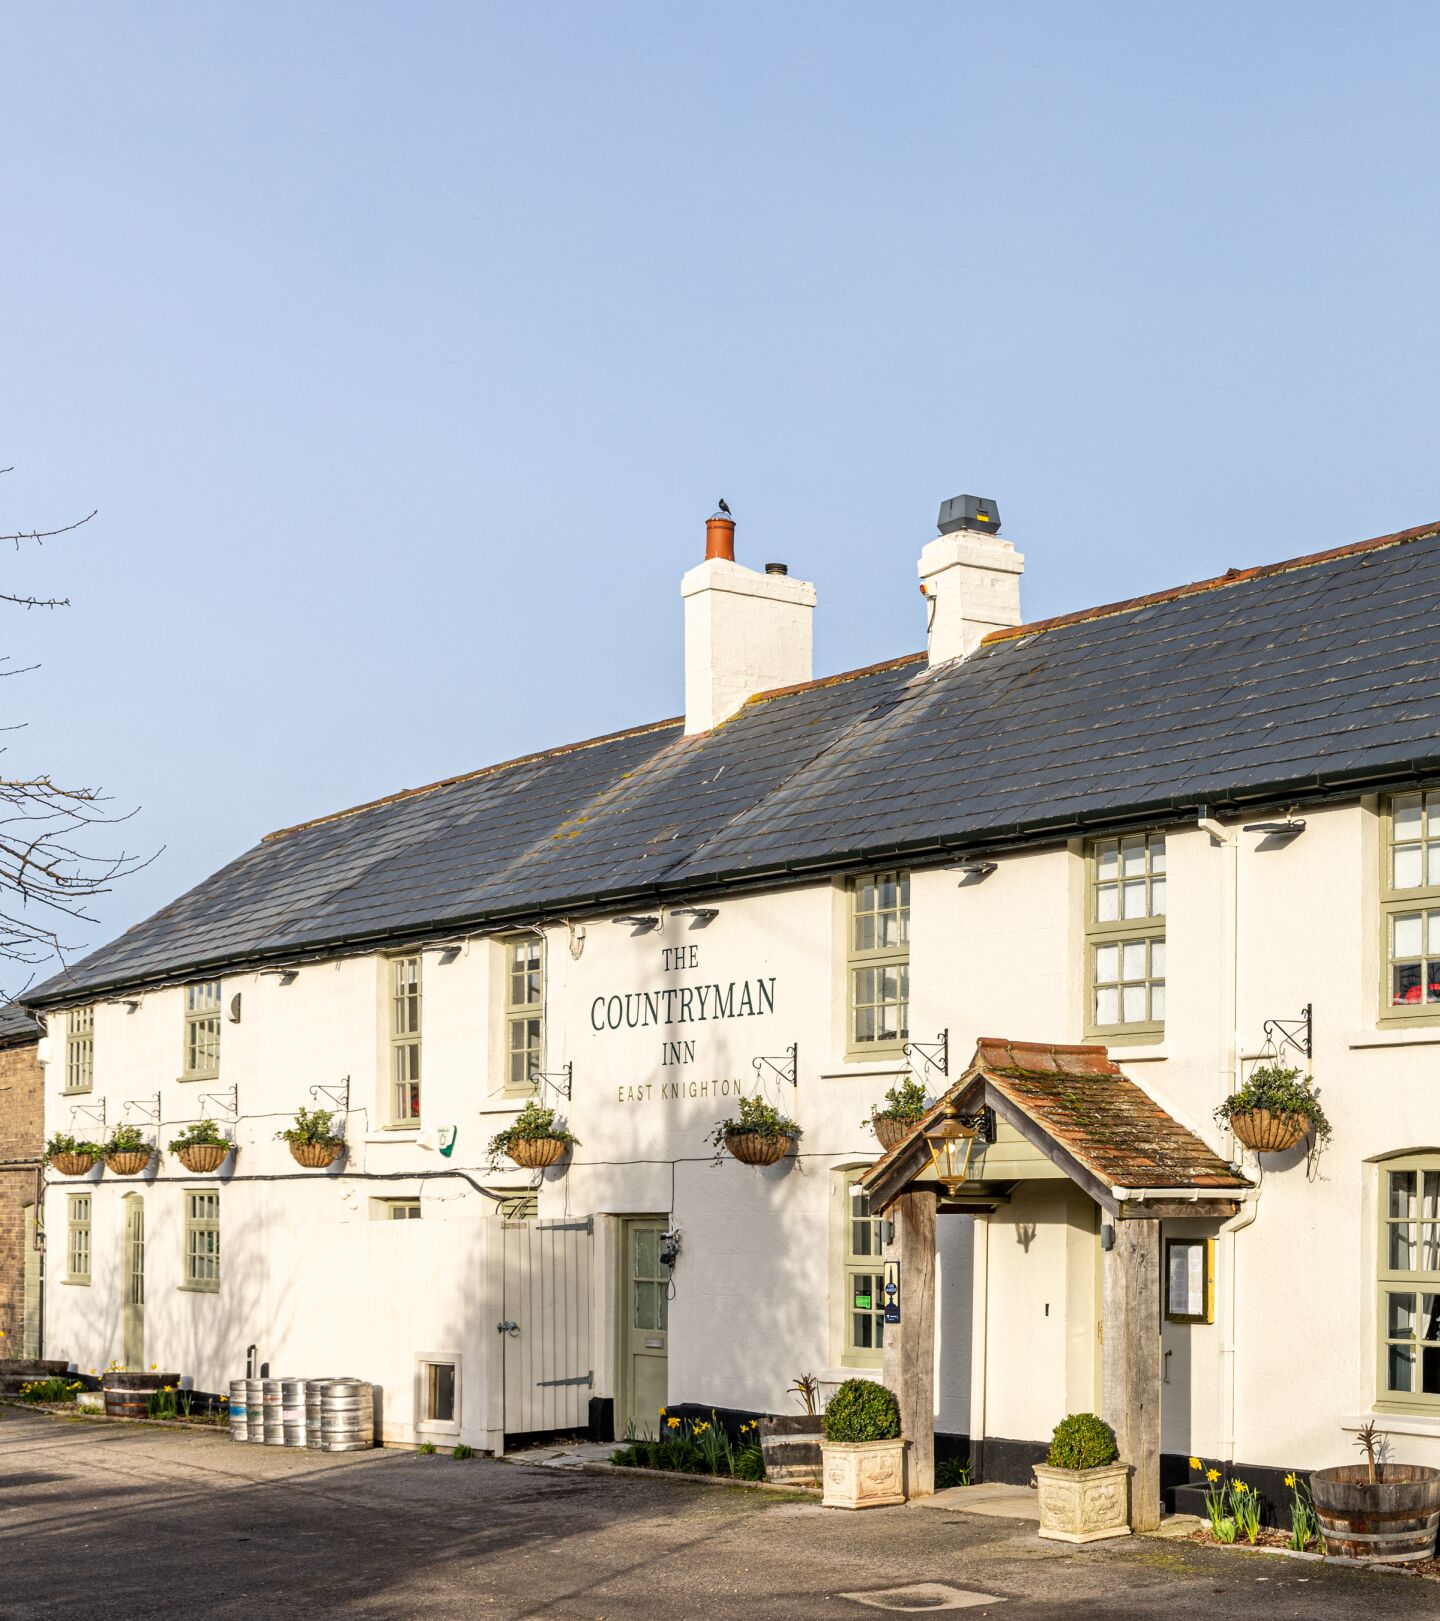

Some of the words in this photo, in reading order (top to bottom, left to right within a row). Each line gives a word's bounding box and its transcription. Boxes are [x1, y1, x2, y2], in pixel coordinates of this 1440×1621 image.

[662, 944, 699, 972] THE
[591, 977, 777, 1031] COUNTRYMAN
[661, 1040, 696, 1066] INN
[618, 1084, 653, 1102] EAST
[661, 1079, 742, 1100] KNIGHTON
